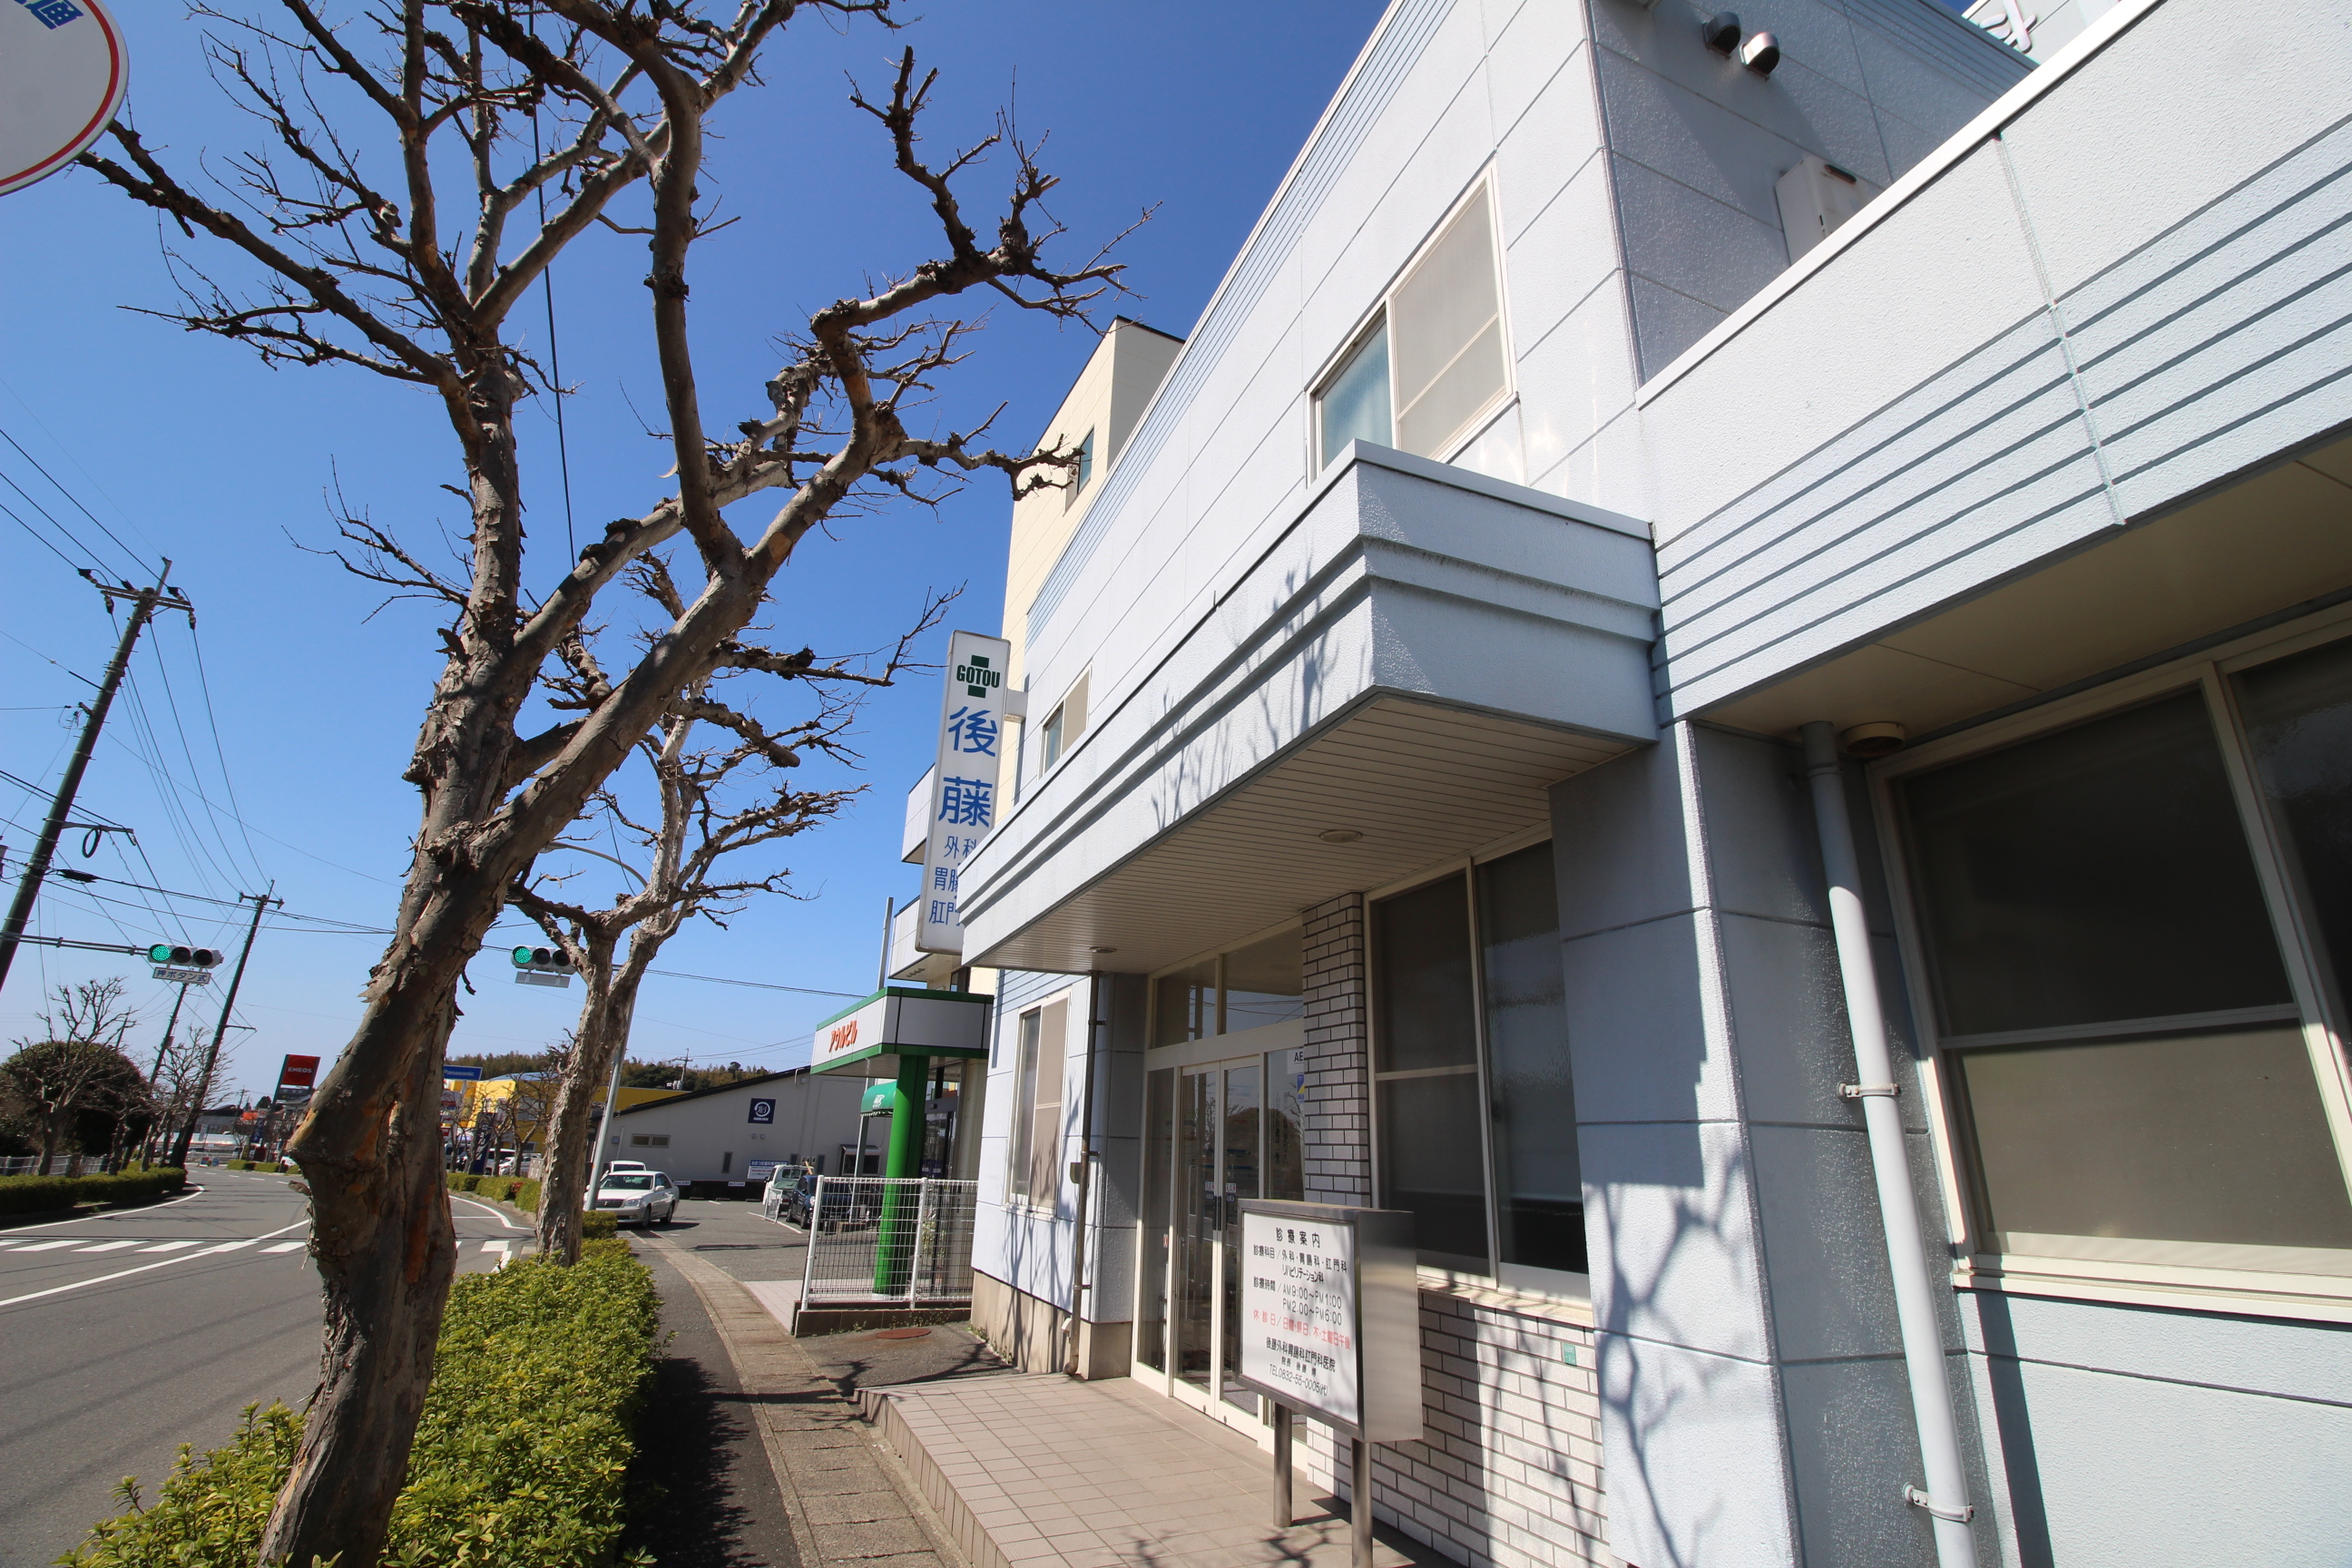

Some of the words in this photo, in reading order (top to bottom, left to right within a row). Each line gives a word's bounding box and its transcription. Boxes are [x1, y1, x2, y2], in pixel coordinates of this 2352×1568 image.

[956, 664, 1000, 689] GOTOU
[938, 706, 998, 828] 後藤
[944, 835, 977, 859] 外科
[934, 867, 958, 893] 胃腸
[928, 900, 961, 926] 肛門
[156, 969, 208, 982] 押ボタン式
[828, 1020, 858, 1053] アウルビル
[1294, 1052, 1304, 1062] AE
[1276, 1227, 1320, 1249] 診療案内
[1282, 1264, 1324, 1285] リハビリテーション科
[1266, 1337, 1336, 1373] 後藤外科胃腸科肛門科医院
